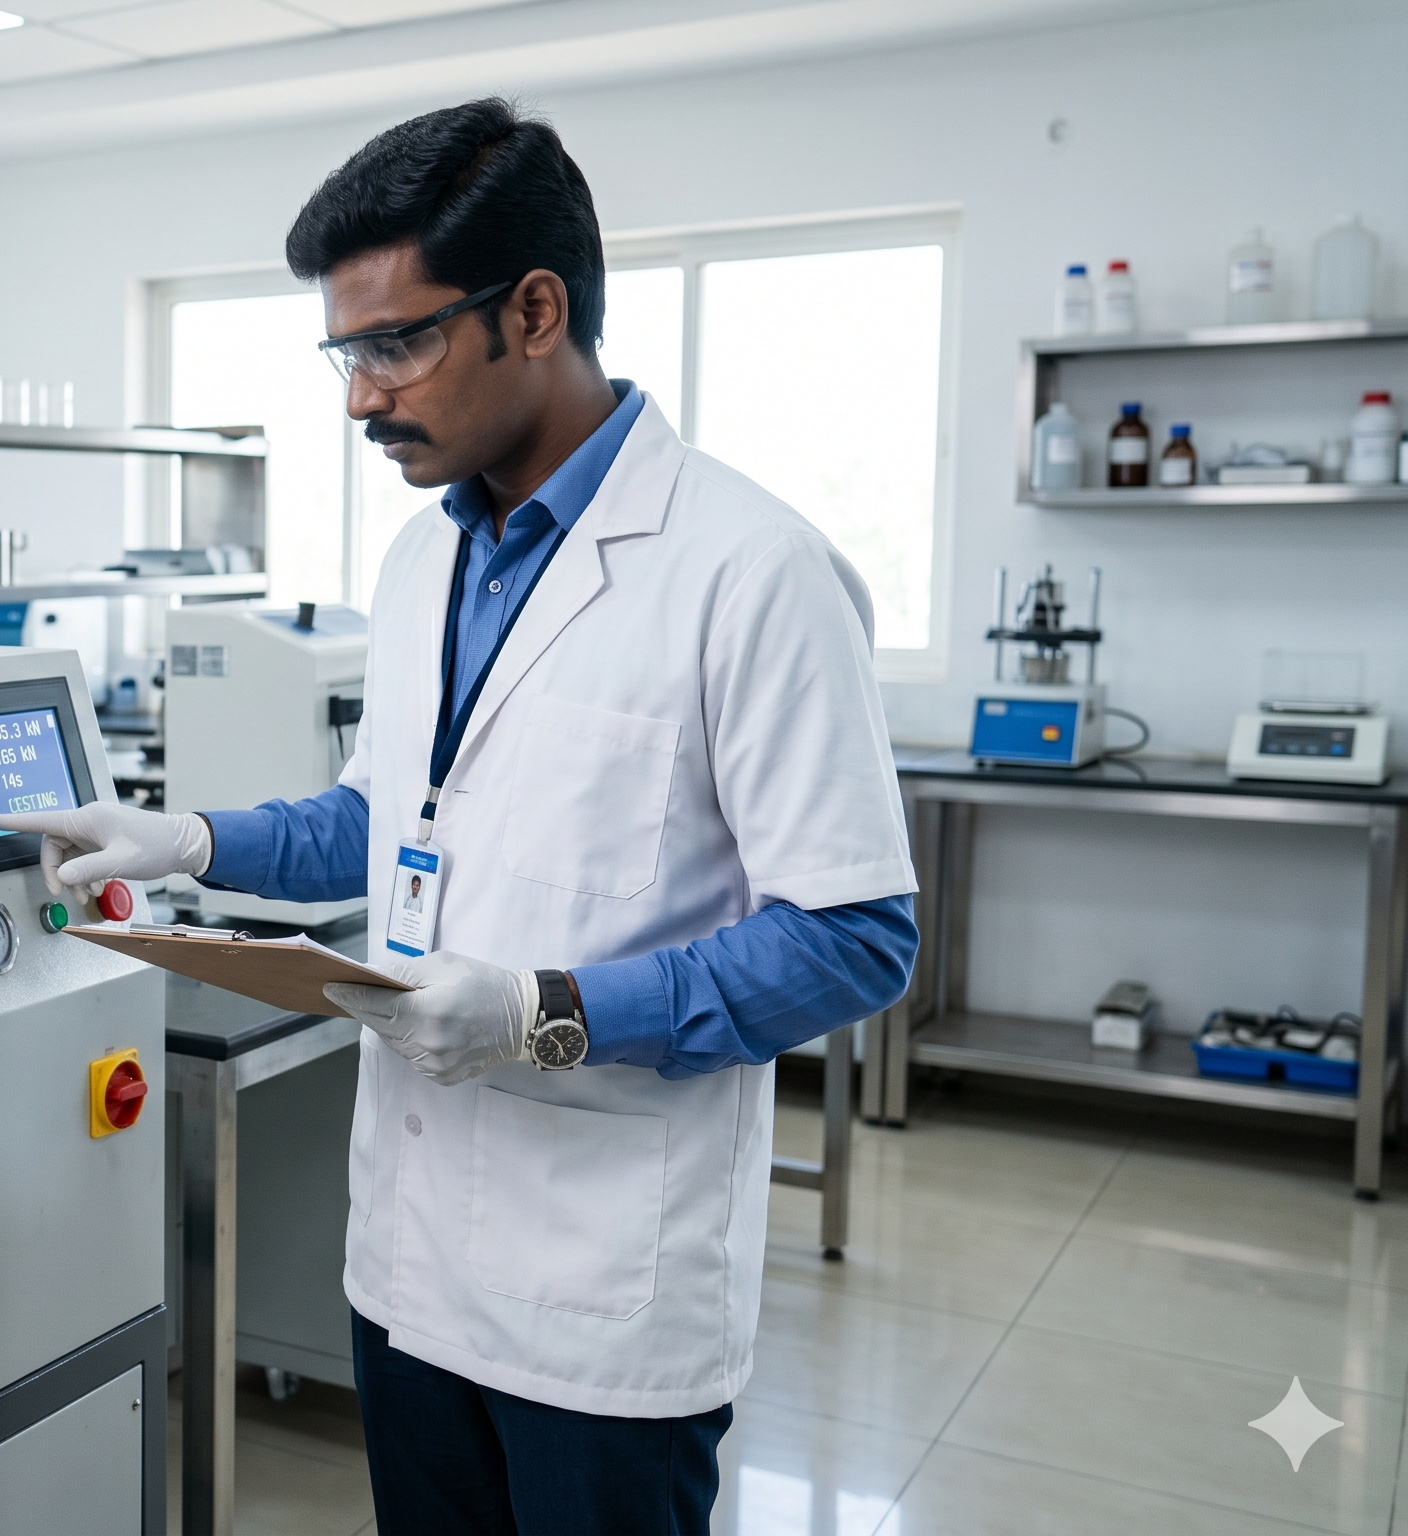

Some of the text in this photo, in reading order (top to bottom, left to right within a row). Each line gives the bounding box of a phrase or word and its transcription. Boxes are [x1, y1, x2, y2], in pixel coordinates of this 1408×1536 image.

[25, 720, 41, 736] kN
[20, 745, 37, 761] kN
[2, 772, 23, 789] 14s
